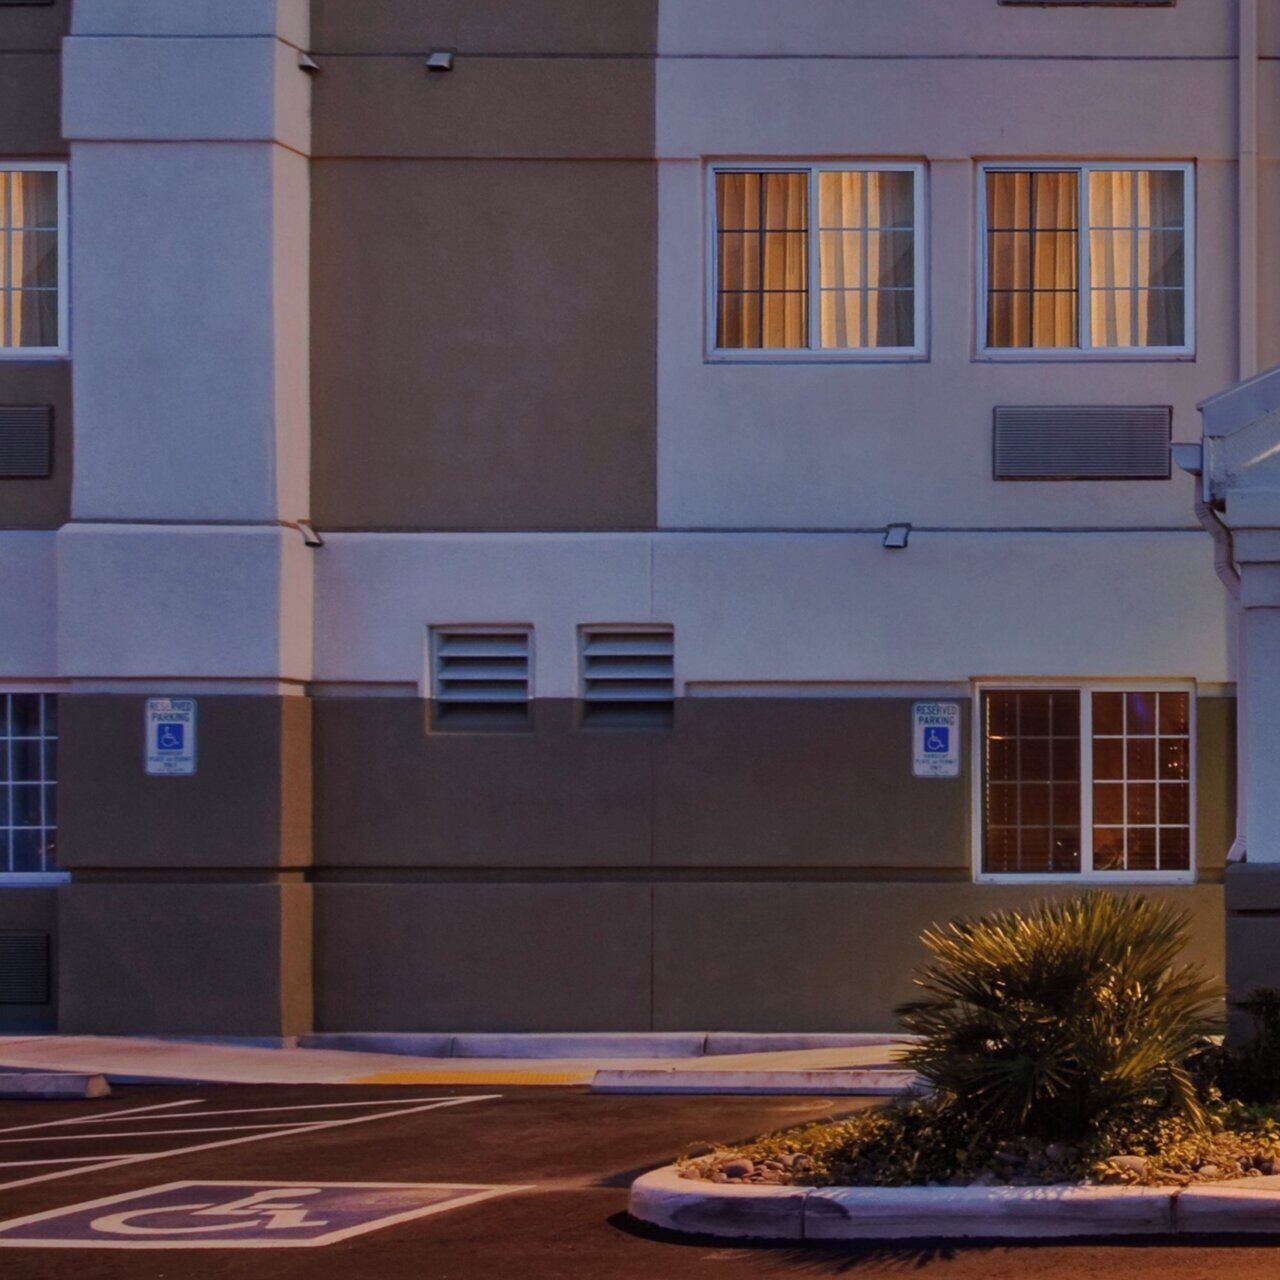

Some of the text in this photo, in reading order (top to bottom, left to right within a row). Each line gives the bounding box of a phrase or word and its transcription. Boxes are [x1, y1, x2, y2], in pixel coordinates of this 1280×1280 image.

[150, 701, 192, 712] RESERVED
[916, 705, 957, 715] RESERVED
[152, 713, 190, 722] PARKING
[919, 716, 955, 726] PARKING
